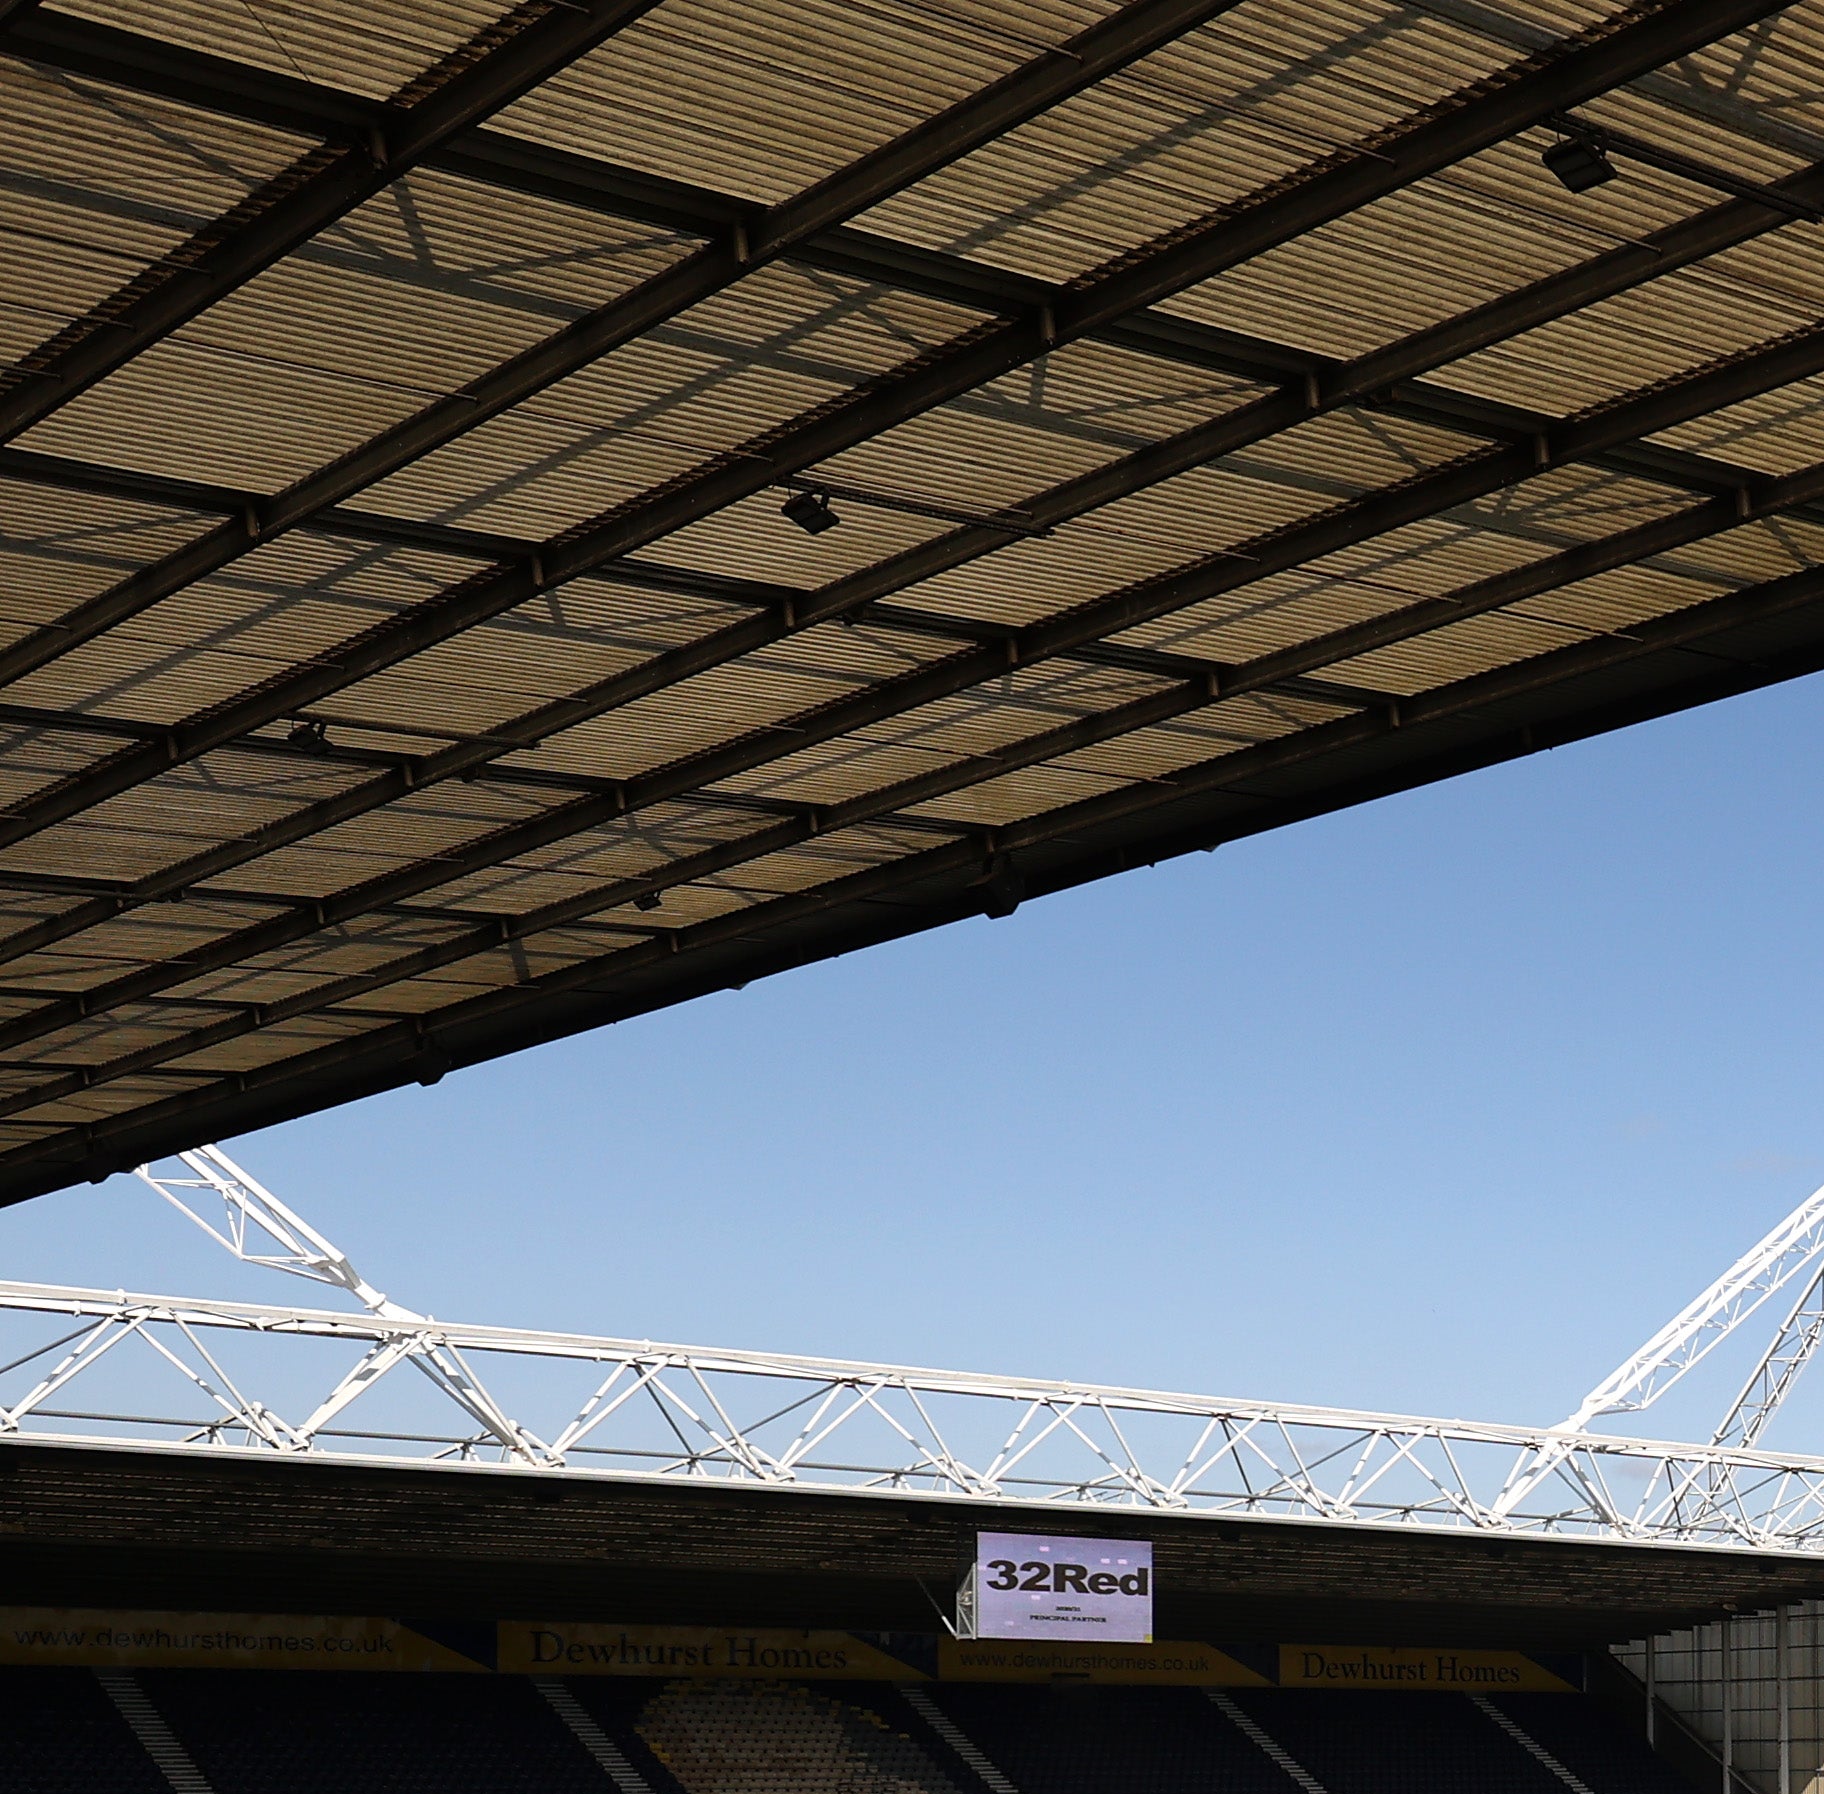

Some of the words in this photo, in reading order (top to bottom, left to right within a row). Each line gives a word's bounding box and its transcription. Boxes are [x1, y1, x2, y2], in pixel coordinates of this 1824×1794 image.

[986, 1559, 1149, 1596] 32Red
[1029, 1614, 1071, 1622] PRINCIPAL
[1072, 1614, 1106, 1623] PARTNER
[15, 1628, 393, 1655] www.dewhursthomes.co.uk
[530, 1631, 711, 1666] Dewhurst
[726, 1637, 848, 1671] Homes
[959, 1651, 1209, 1672] www.dewhursthomes.co.uk
[1302, 1652, 1427, 1681] Dewhurst
[1436, 1656, 1521, 1684] Homes
